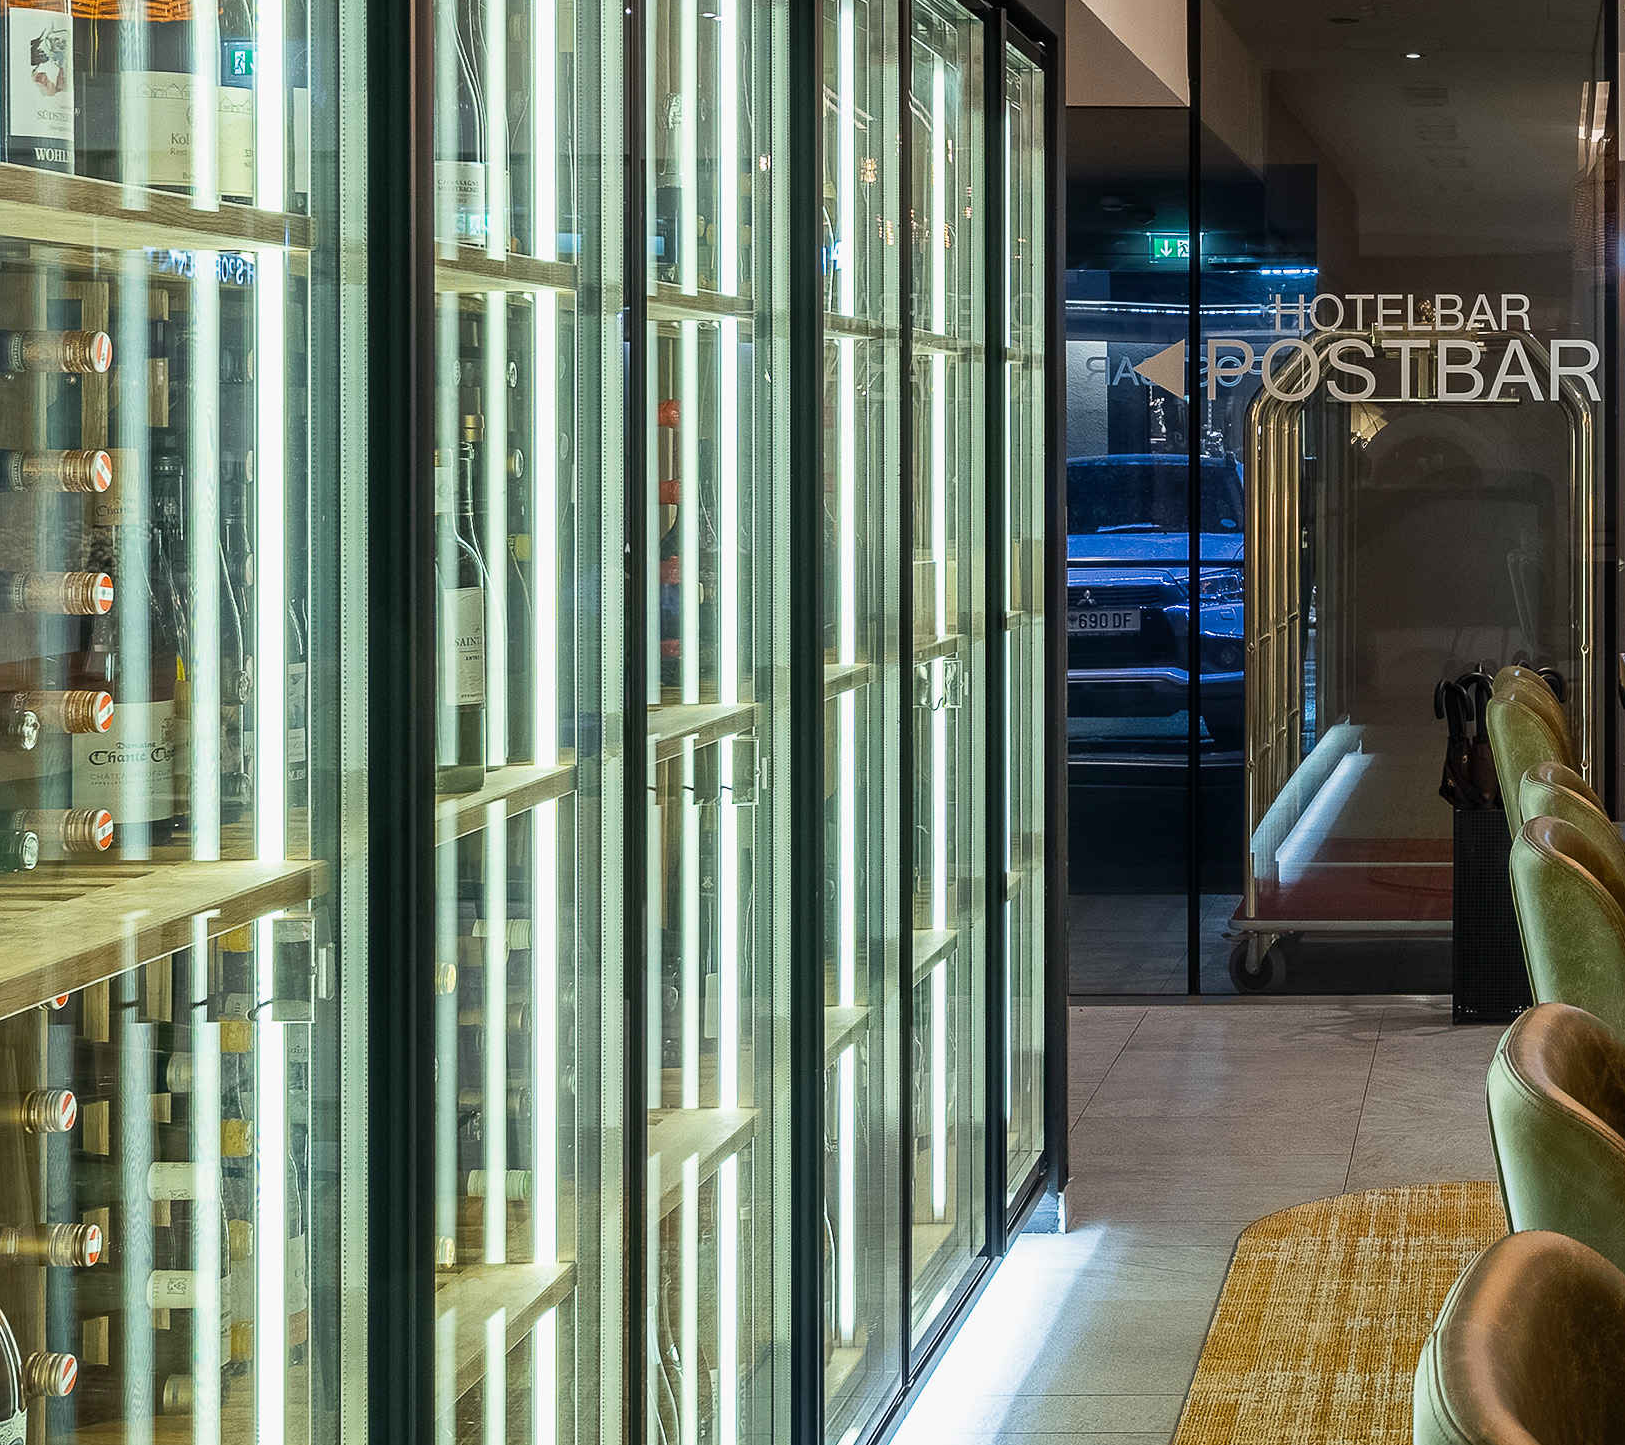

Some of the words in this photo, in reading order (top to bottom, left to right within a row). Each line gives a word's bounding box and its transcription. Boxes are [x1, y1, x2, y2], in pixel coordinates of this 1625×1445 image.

[1274, 293, 1531, 332] HOTELBAR
[1207, 338, 1602, 402] POSTBAR
[1078, 612, 1109, 629] 690
[1113, 612, 1133, 629] DF
